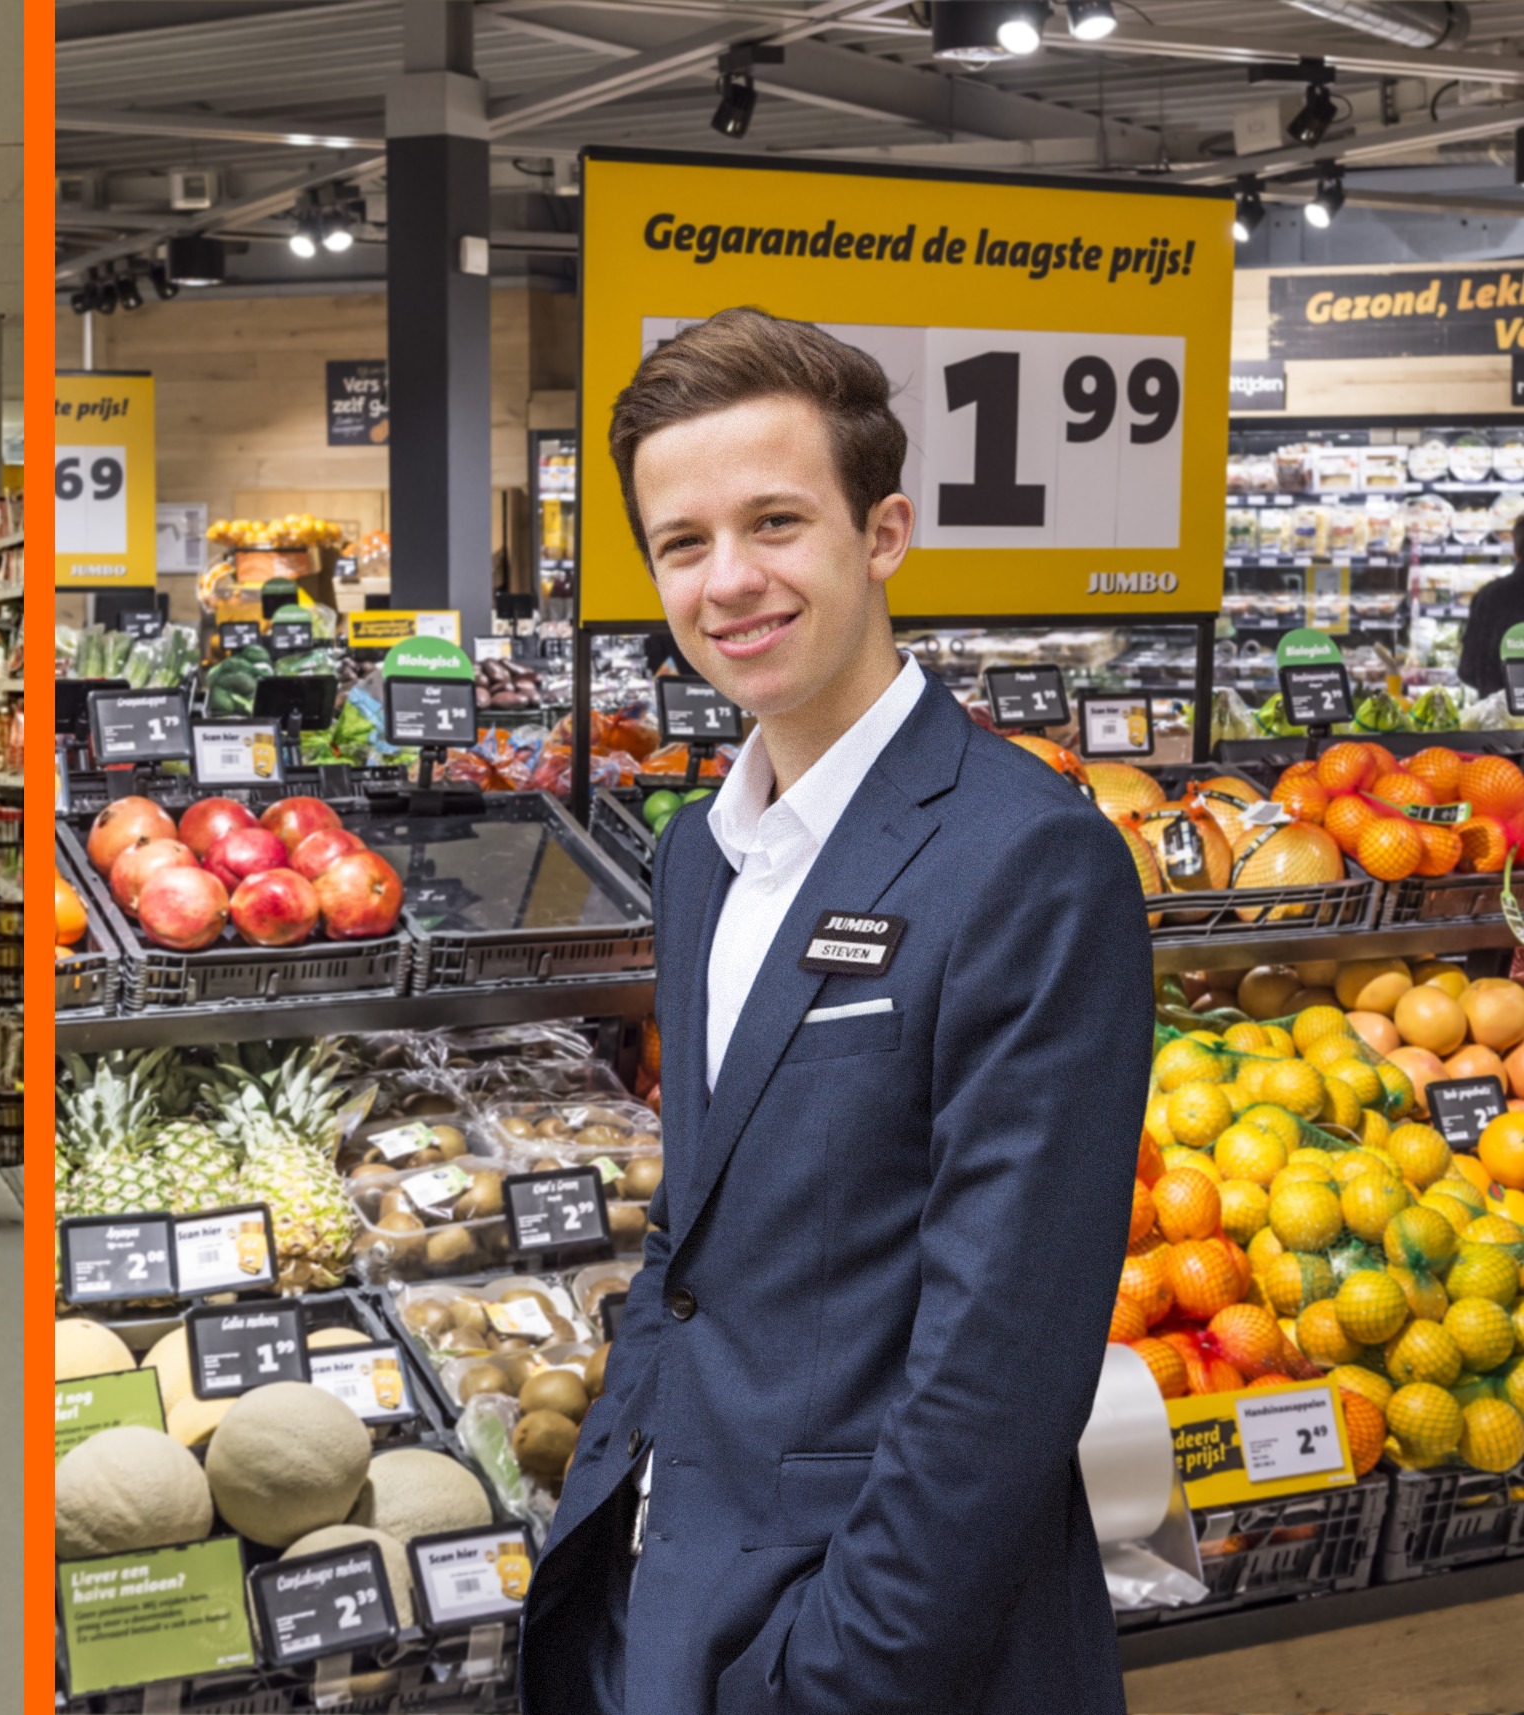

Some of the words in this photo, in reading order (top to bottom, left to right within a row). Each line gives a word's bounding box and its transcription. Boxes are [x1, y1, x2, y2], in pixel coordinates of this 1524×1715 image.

[643, 212, 915, 264] Gegarandeerd
[922, 226, 965, 265] de
[975, 229, 1103, 279] laagste
[1109, 238, 1195, 285] prijs!
[1305, 279, 1448, 324] Gezond,
[1456, 273, 1524, 311] Lek
[1495, 317, 1524, 350] V
[343, 377, 380, 393] Vers
[76, 397, 129, 421] prijs!
[332, 396, 366, 414] zelf
[55, 457, 123, 501] 69
[70, 564, 127, 577] JUMBO
[1086, 571, 1178, 595] JUMBO
[1285, 644, 1331, 658] Biologisch
[397, 654, 461, 671] Biologisch
[202, 733, 221, 742] Scan
[223, 733, 240, 741] hier
[824, 916, 889, 935] JUMBO
[821, 944, 871, 959] STEVEN
[178, 1229, 200, 1241] Scan
[202, 1226, 221, 1236] hier
[334, 1362, 354, 1372] hier
[1244, 1399, 1327, 1418] Handsinaasappelen
[1176, 1423, 1220, 1450] deerd
[1186, 1443, 1226, 1473] prijs!
[429, 1553, 454, 1565] Scan
[456, 1548, 478, 1560] hier
[71, 1568, 118, 1588] Liever
[121, 1564, 150, 1581] een
[72, 1584, 117, 1604] halve
[120, 1572, 186, 1597] meloen?
